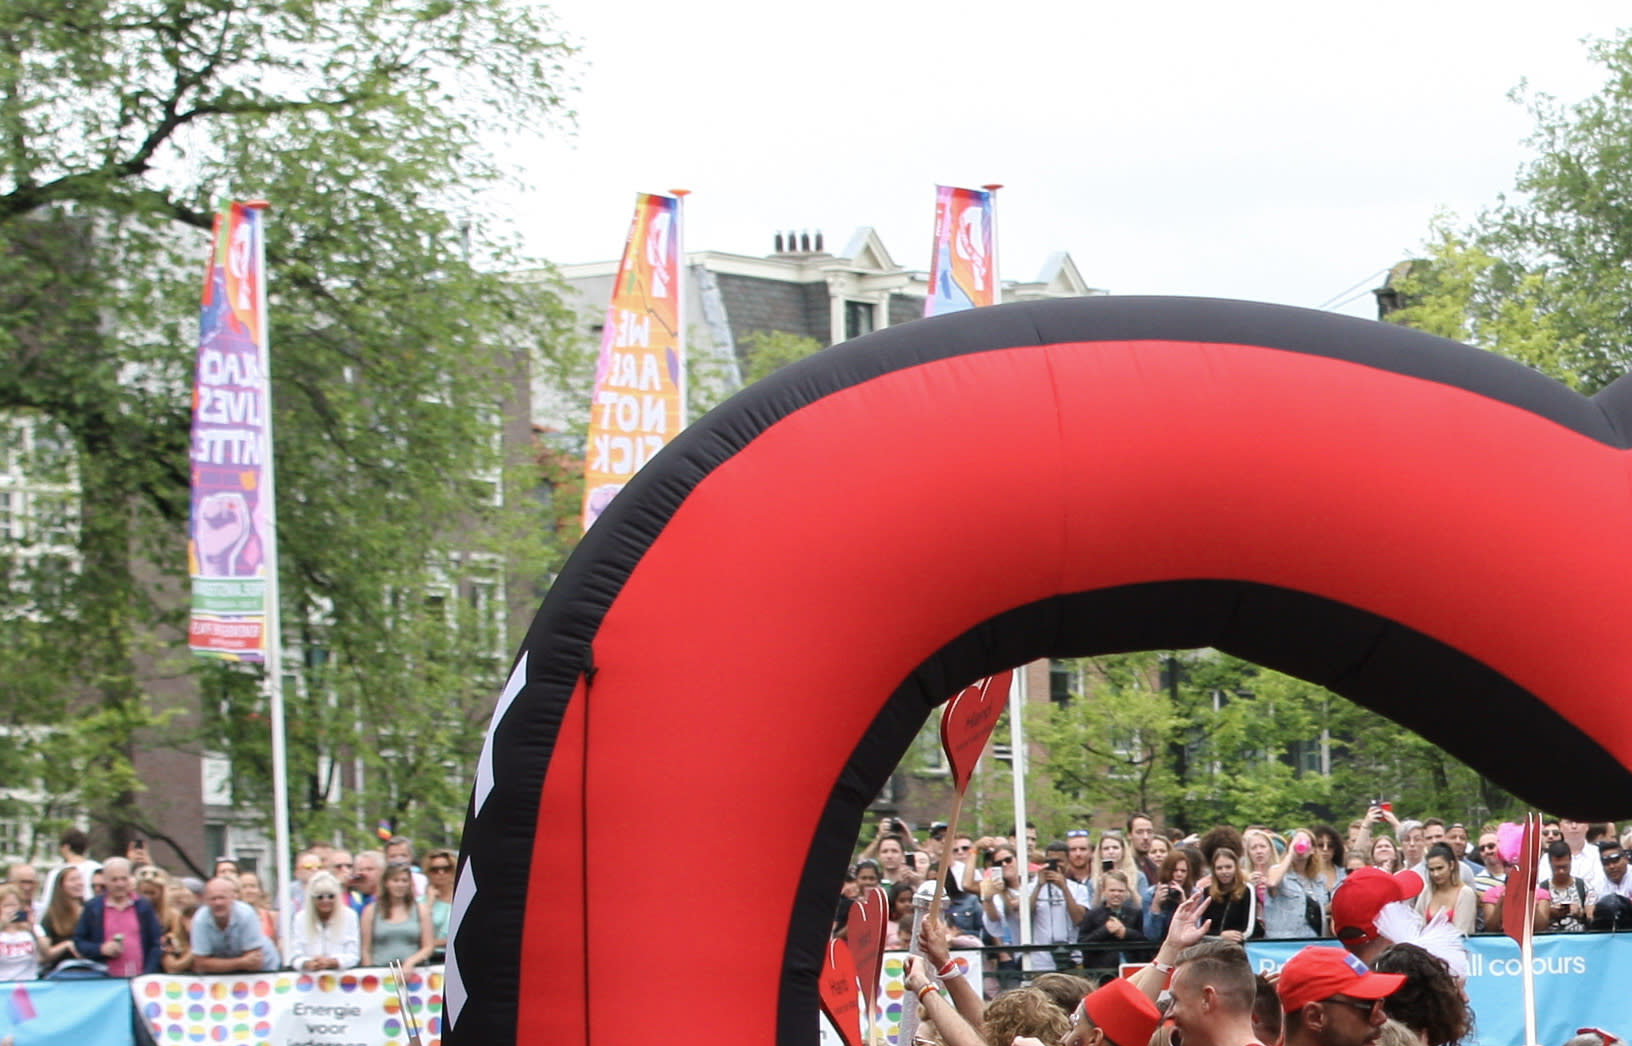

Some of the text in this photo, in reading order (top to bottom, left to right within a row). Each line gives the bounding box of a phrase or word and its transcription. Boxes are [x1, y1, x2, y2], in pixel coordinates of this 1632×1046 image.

[1488, 956, 1586, 977] coours
[293, 1002, 361, 1020] Energie
[305, 1024, 348, 1035] voor
